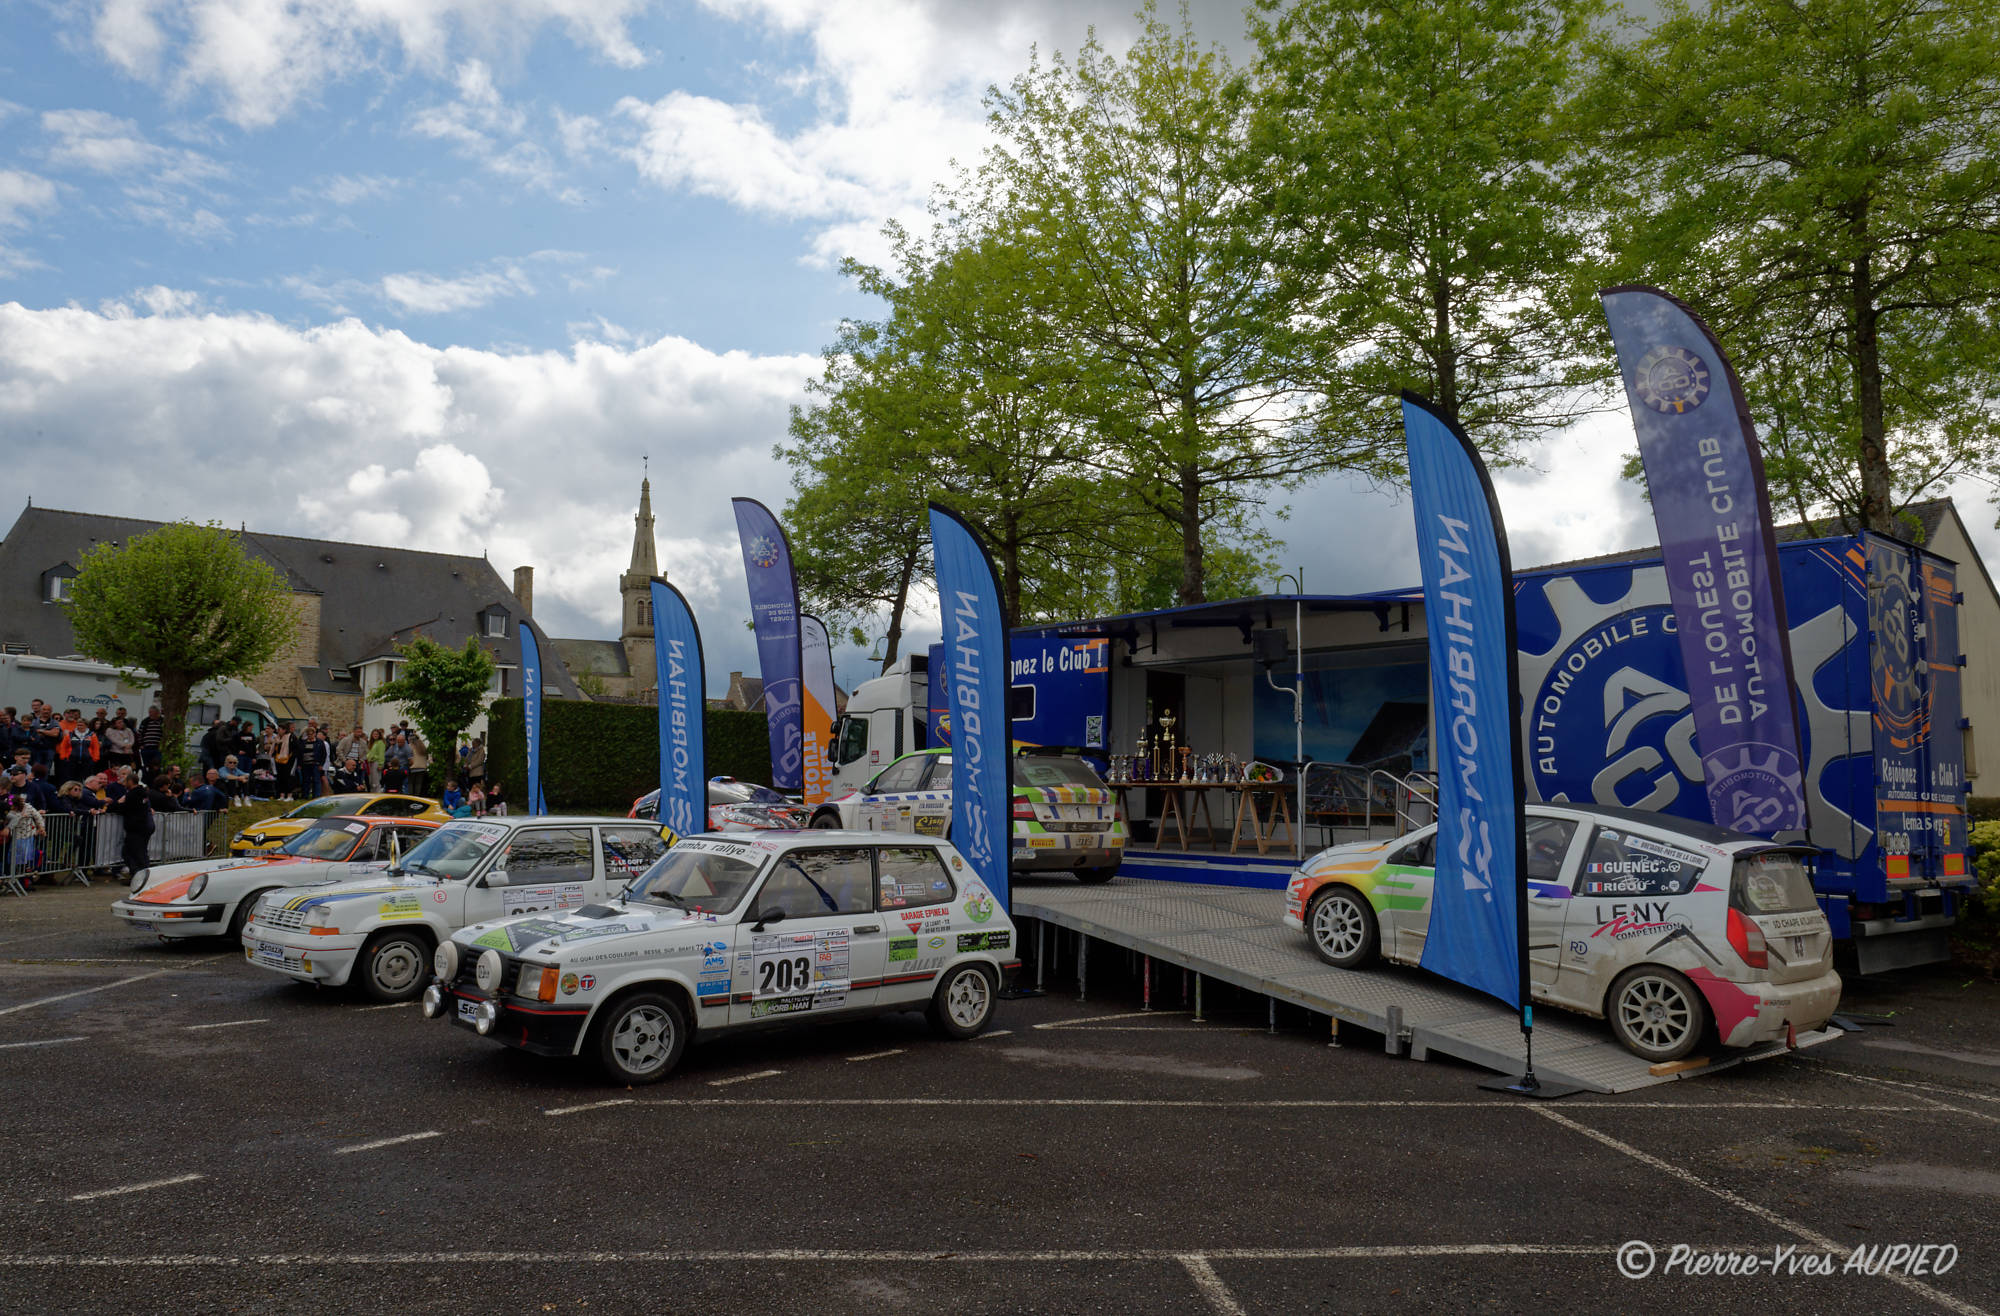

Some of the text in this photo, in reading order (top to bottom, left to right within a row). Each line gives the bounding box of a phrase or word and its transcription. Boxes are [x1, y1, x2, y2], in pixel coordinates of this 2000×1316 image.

[1042, 649, 1054, 673] le
[1060, 643, 1091, 671] Club
[1097, 642, 1103, 667] !
[1538, 616, 1649, 774] AUTOMOBILE
[1882, 757, 1917, 790] Rejoignez
[1938, 762, 1954, 787] Club
[1887, 790, 1918, 800] AUTOMOBILE
[712, 843, 746, 856] rallye
[1603, 861, 1659, 874] GUENEC
[901, 907, 950, 921] GARAGE EPINEAU
[1596, 901, 1670, 925] LENY
[608, 951, 639, 960] COULEURS
[704, 956, 724, 967] AMS
[760, 957, 810, 995] 203
